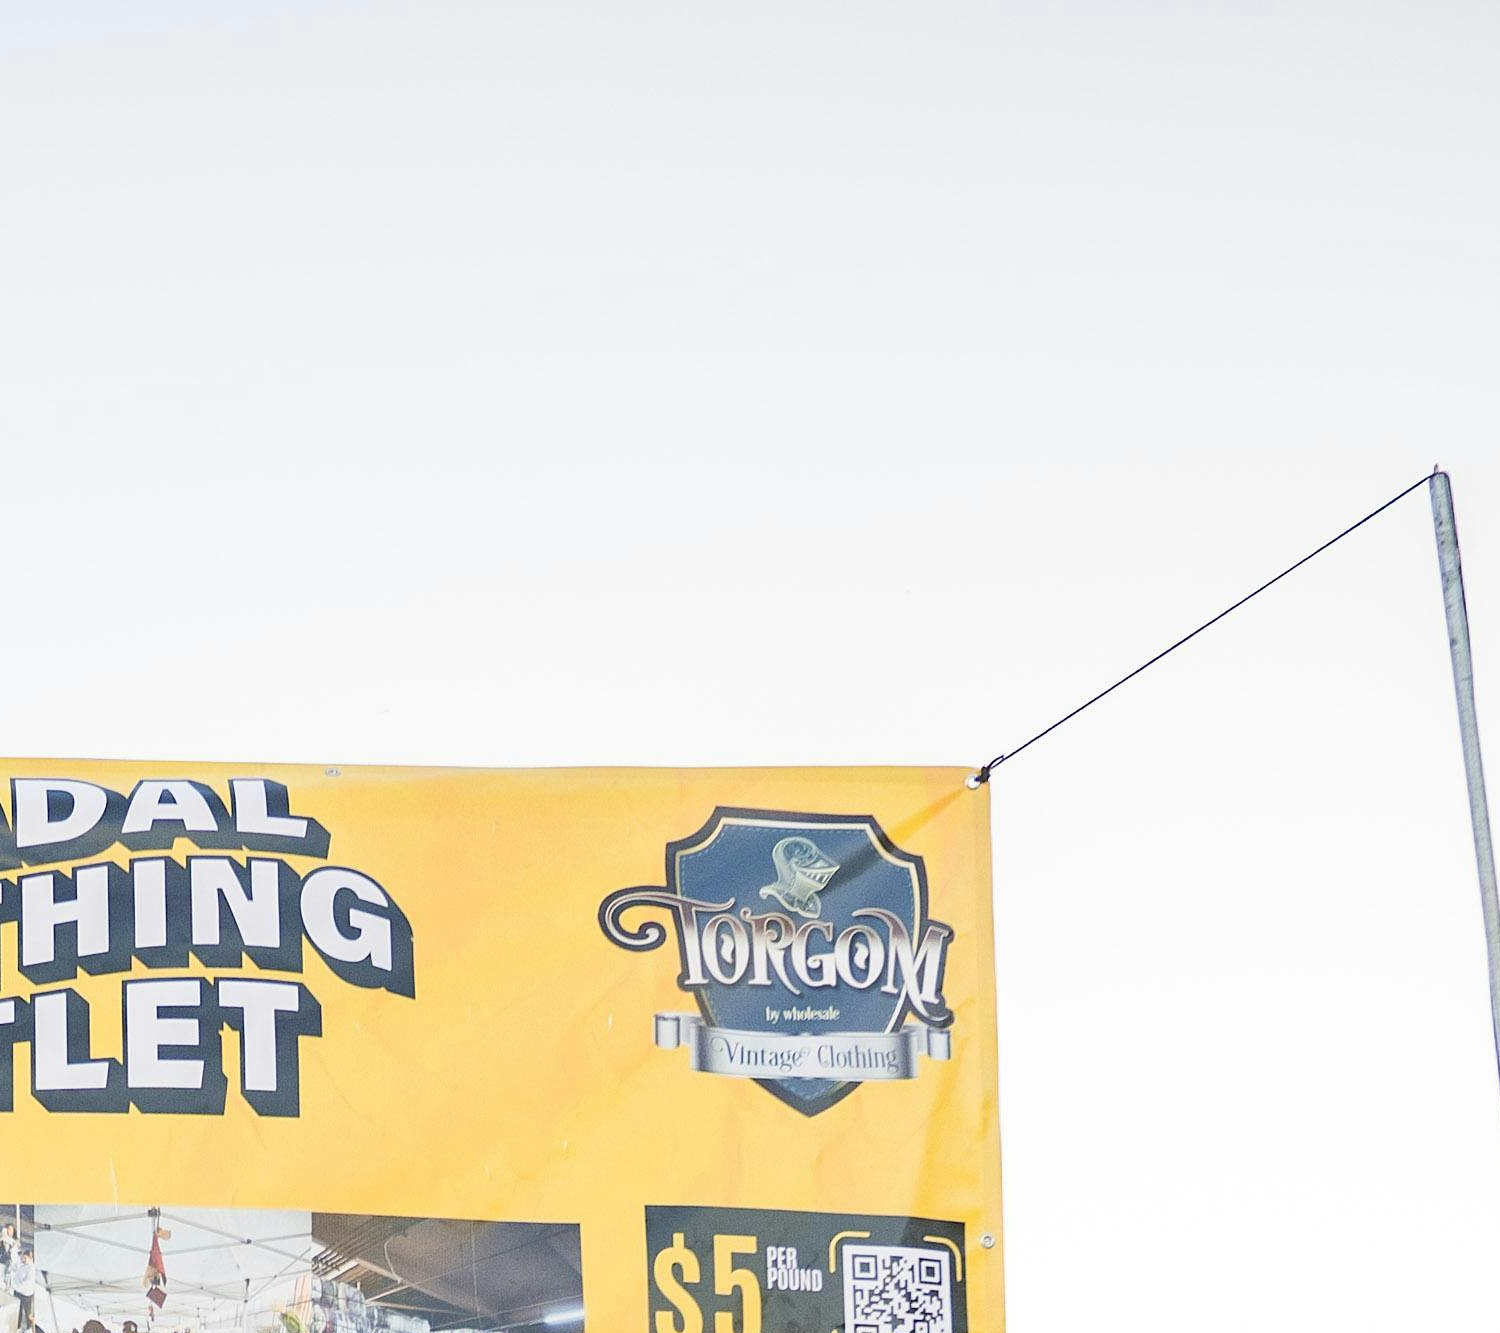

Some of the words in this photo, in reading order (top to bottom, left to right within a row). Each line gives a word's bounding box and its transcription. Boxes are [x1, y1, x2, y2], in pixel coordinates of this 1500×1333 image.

[602, 890, 952, 1022] TORGOM
[765, 1007, 779, 1022] by
[782, 1006, 840, 1021] wholesale
[710, 1037, 803, 1069] Vintage
[818, 1045, 899, 1073] Clothing
[767, 1246, 798, 1269] PER
[767, 1268, 823, 1292] POUND
